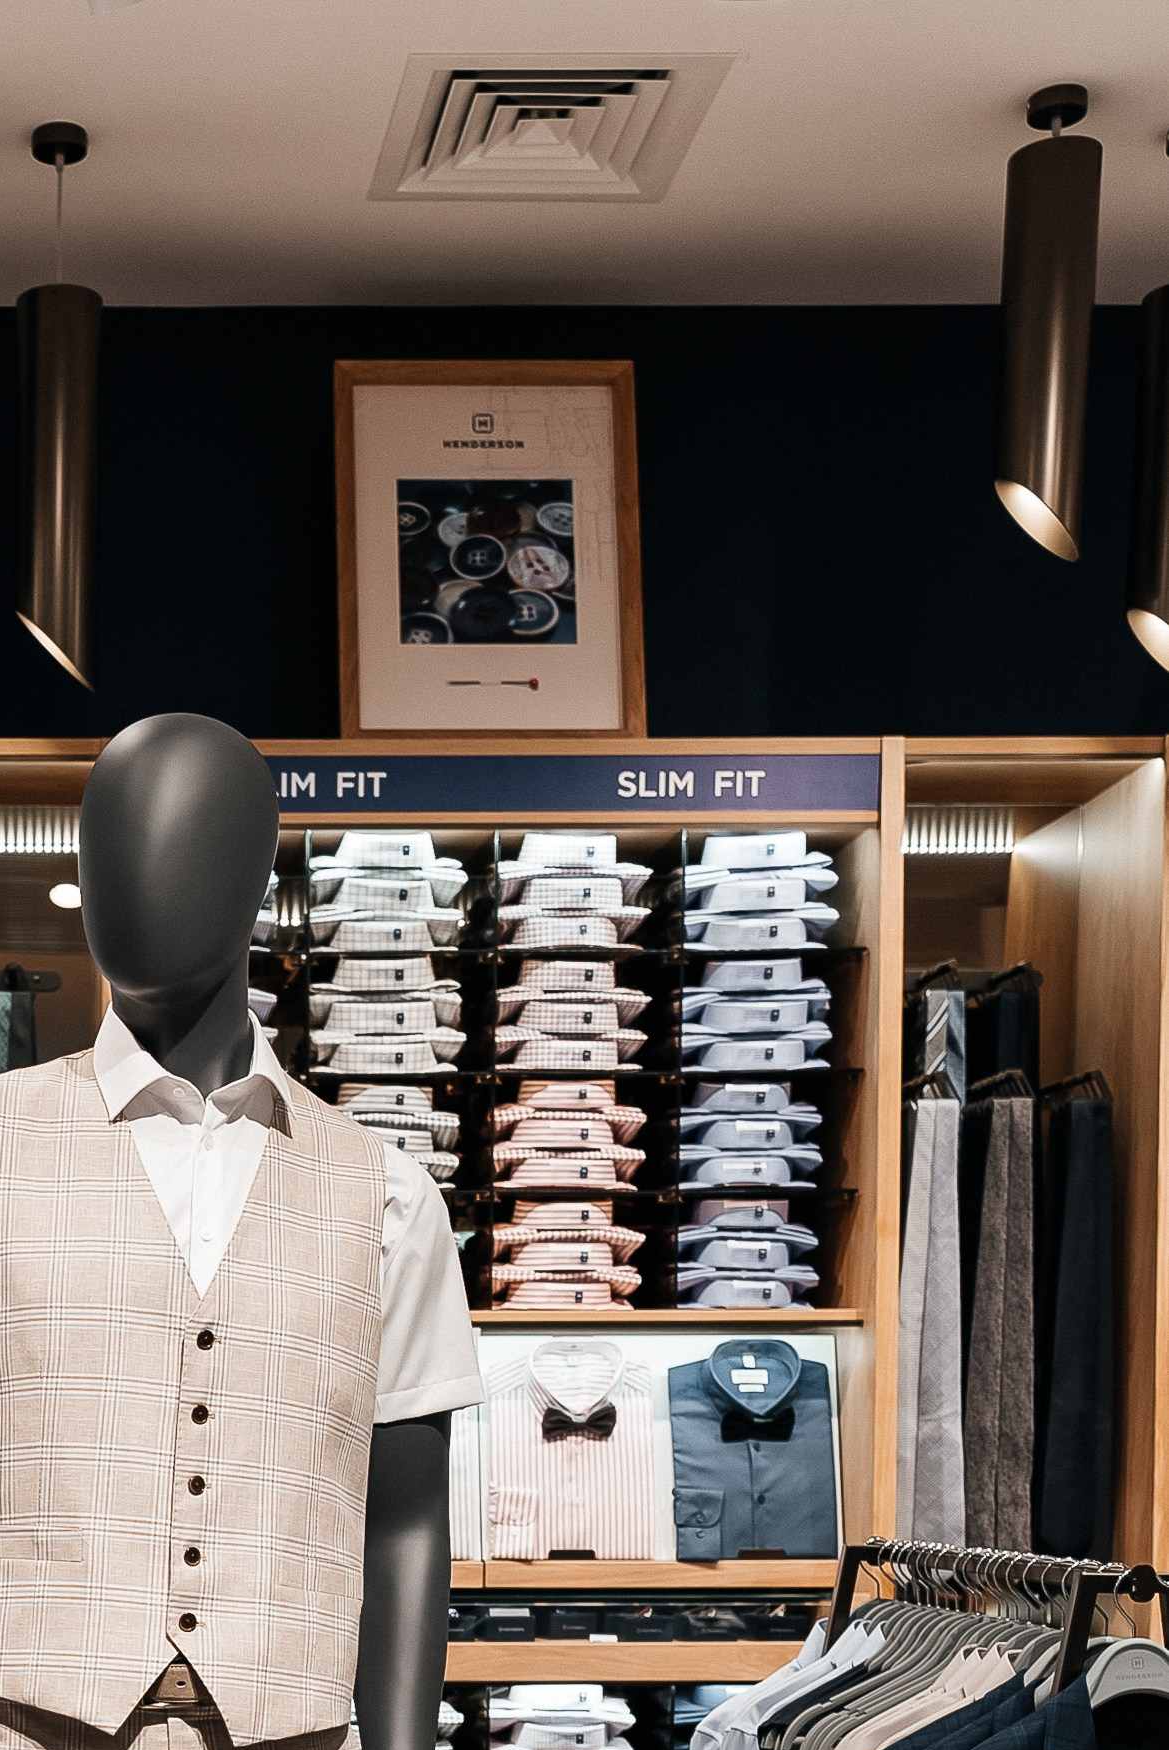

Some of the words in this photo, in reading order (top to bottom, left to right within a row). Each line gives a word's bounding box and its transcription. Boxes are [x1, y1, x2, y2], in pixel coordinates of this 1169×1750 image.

[442, 440, 525, 449] HENDERSON
[276, 771, 316, 798] IM
[336, 771, 388, 798] FIT
[617, 770, 695, 798] SLIM
[715, 770, 767, 798] FIT
[1115, 1672, 1164, 1681] HENDERSON
